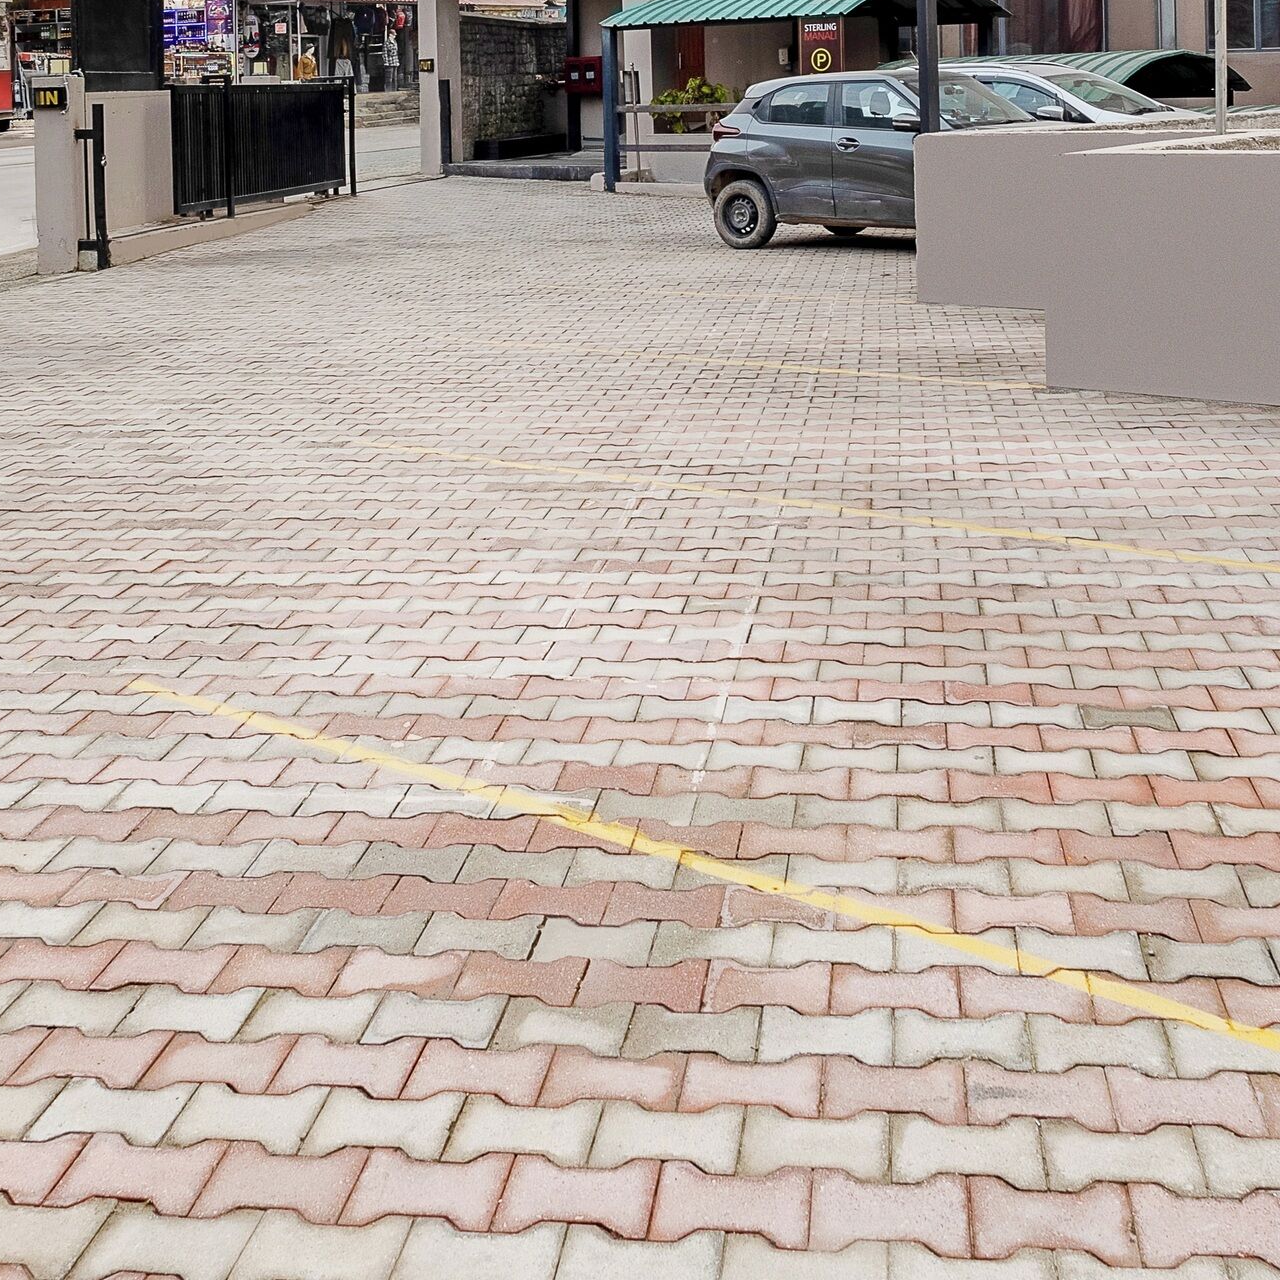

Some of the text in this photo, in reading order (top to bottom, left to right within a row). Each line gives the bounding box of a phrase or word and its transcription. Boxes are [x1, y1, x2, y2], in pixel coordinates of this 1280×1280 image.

[804, 23, 837, 32] STERLING
[804, 31, 837, 40] MANALI
[817, 53, 827, 67] P
[39, 90, 59, 105] IN
